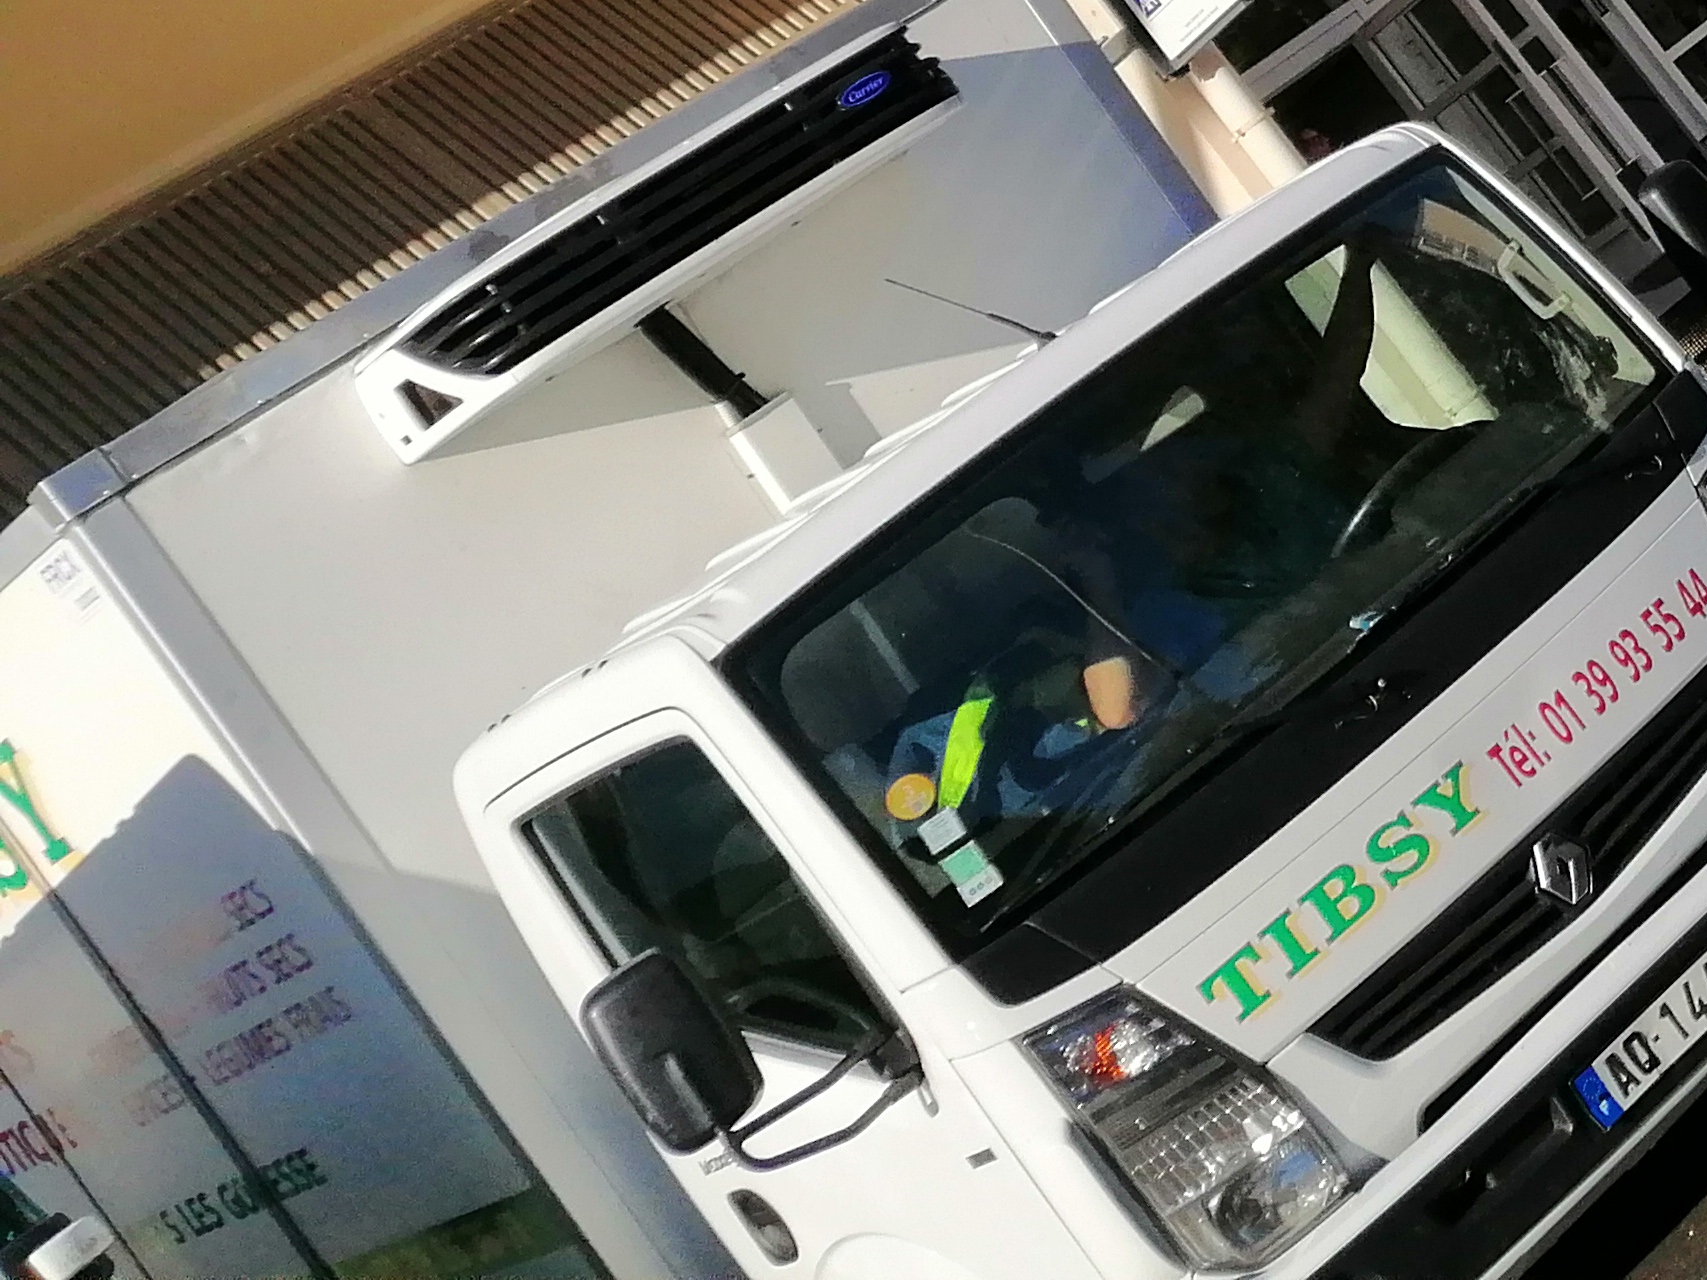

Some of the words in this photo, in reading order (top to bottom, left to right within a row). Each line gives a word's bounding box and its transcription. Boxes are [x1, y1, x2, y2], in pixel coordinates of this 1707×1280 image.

[848, 76, 884, 102] Carrier
[1487, 727, 1551, 789] Tél:
[1538, 690, 1583, 746] 01
[1572, 658, 1621, 715] 39
[1610, 628, 1654, 682] 93
[1641, 598, 1687, 652] 55
[1198, 759, 1488, 1024] TIBSY
[173, 1189, 226, 1239] LES
[214, 1145, 329, 1222] GOESSE
